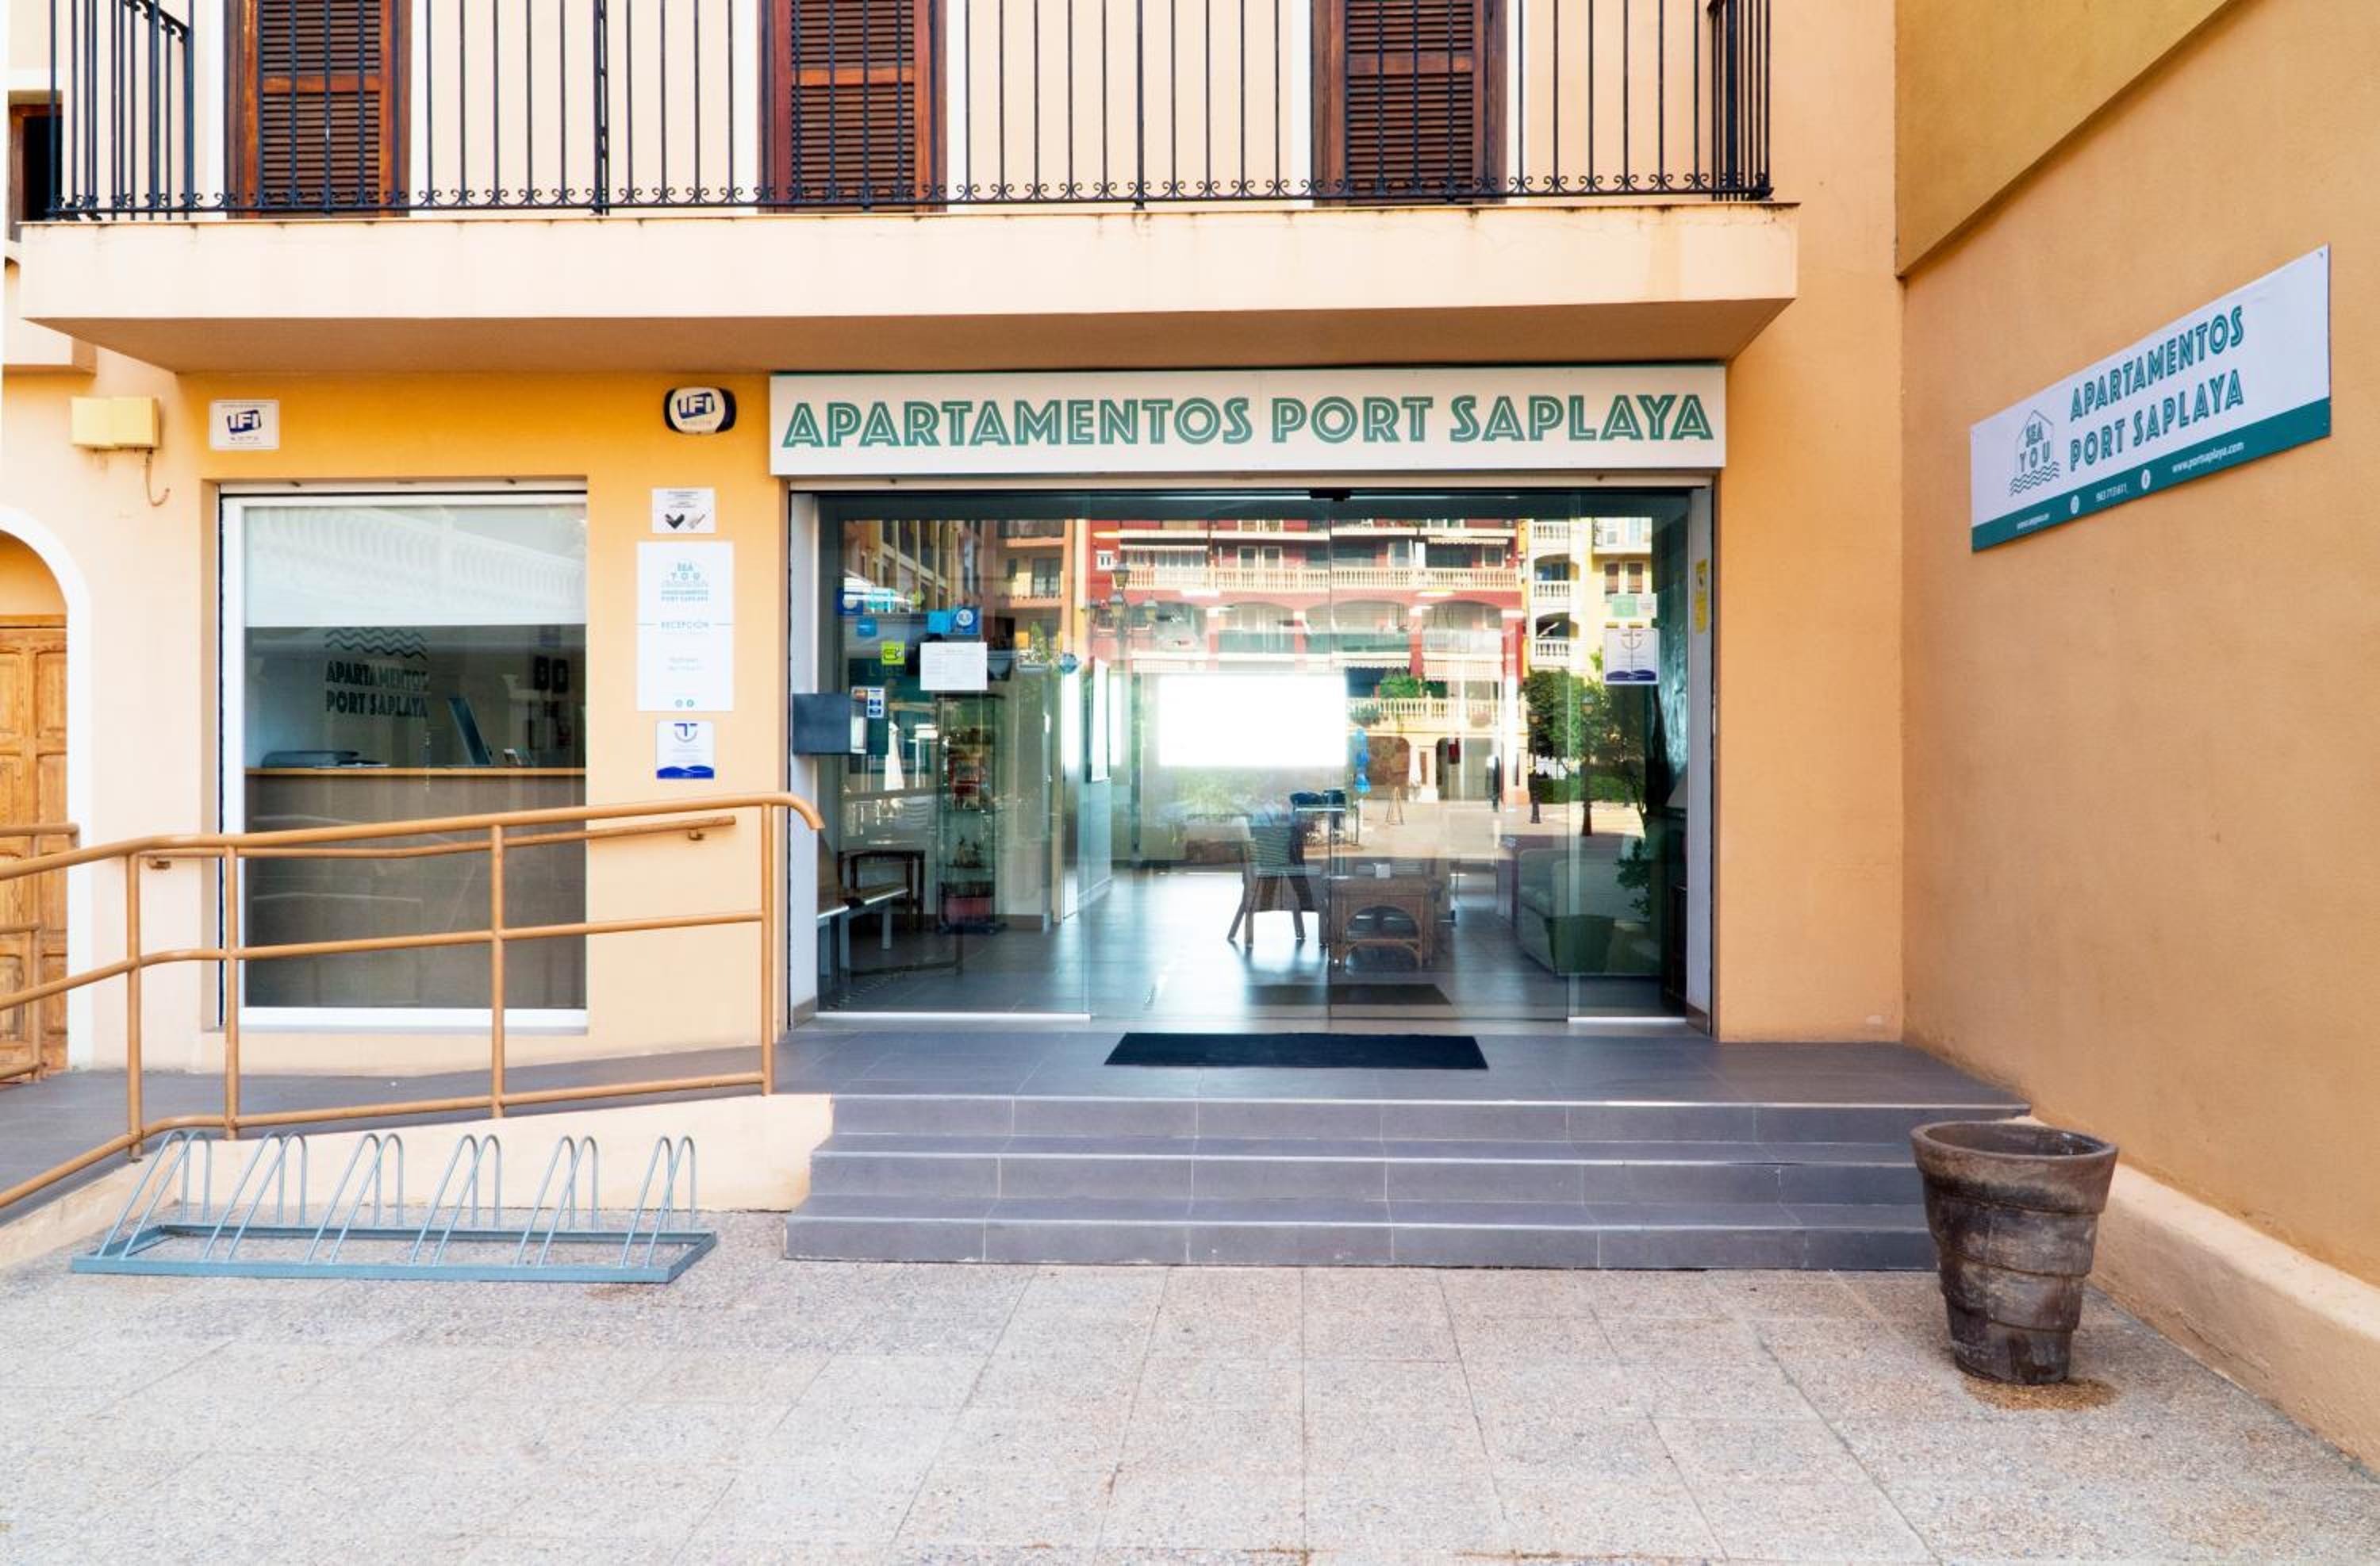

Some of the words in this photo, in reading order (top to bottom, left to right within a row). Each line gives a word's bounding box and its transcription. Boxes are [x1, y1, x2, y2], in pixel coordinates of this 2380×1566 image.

[2070, 305, 2244, 422] APARTAMENTOS
[781, 397, 1252, 448] APARTAMENTOS
[1272, 396, 1434, 443] PORT
[1449, 393, 1714, 442] SAPLAYA
[2025, 420, 2044, 448] SEA
[2070, 419, 2125, 471] PORT
[2133, 368, 2244, 447] SAPLAYA
[2019, 441, 2051, 473] YOU
[326, 690, 366, 714] PORT
[369, 693, 428, 718] SAPLAYA
